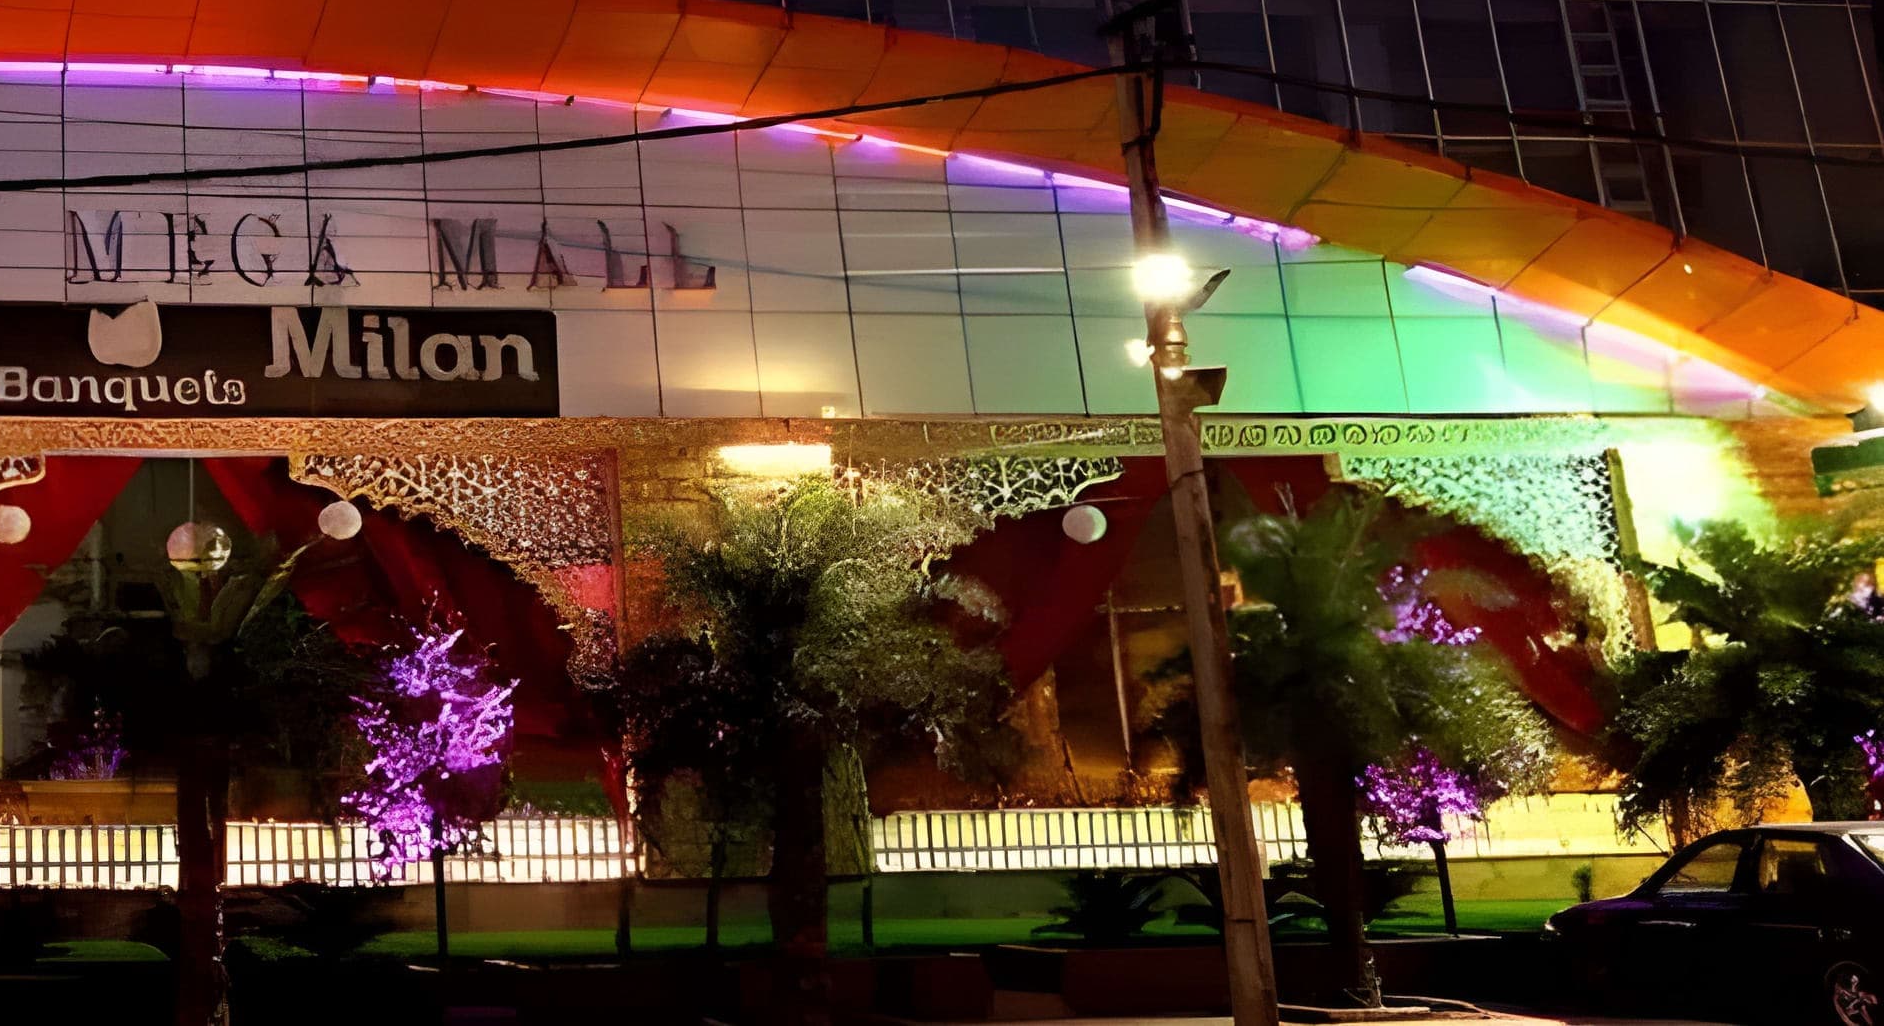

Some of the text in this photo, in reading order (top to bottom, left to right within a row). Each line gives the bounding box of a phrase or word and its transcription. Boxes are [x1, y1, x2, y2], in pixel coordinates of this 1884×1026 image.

[67, 209, 360, 288] MEGA
[432, 218, 716, 292] MALL
[264, 306, 540, 381] Milan
